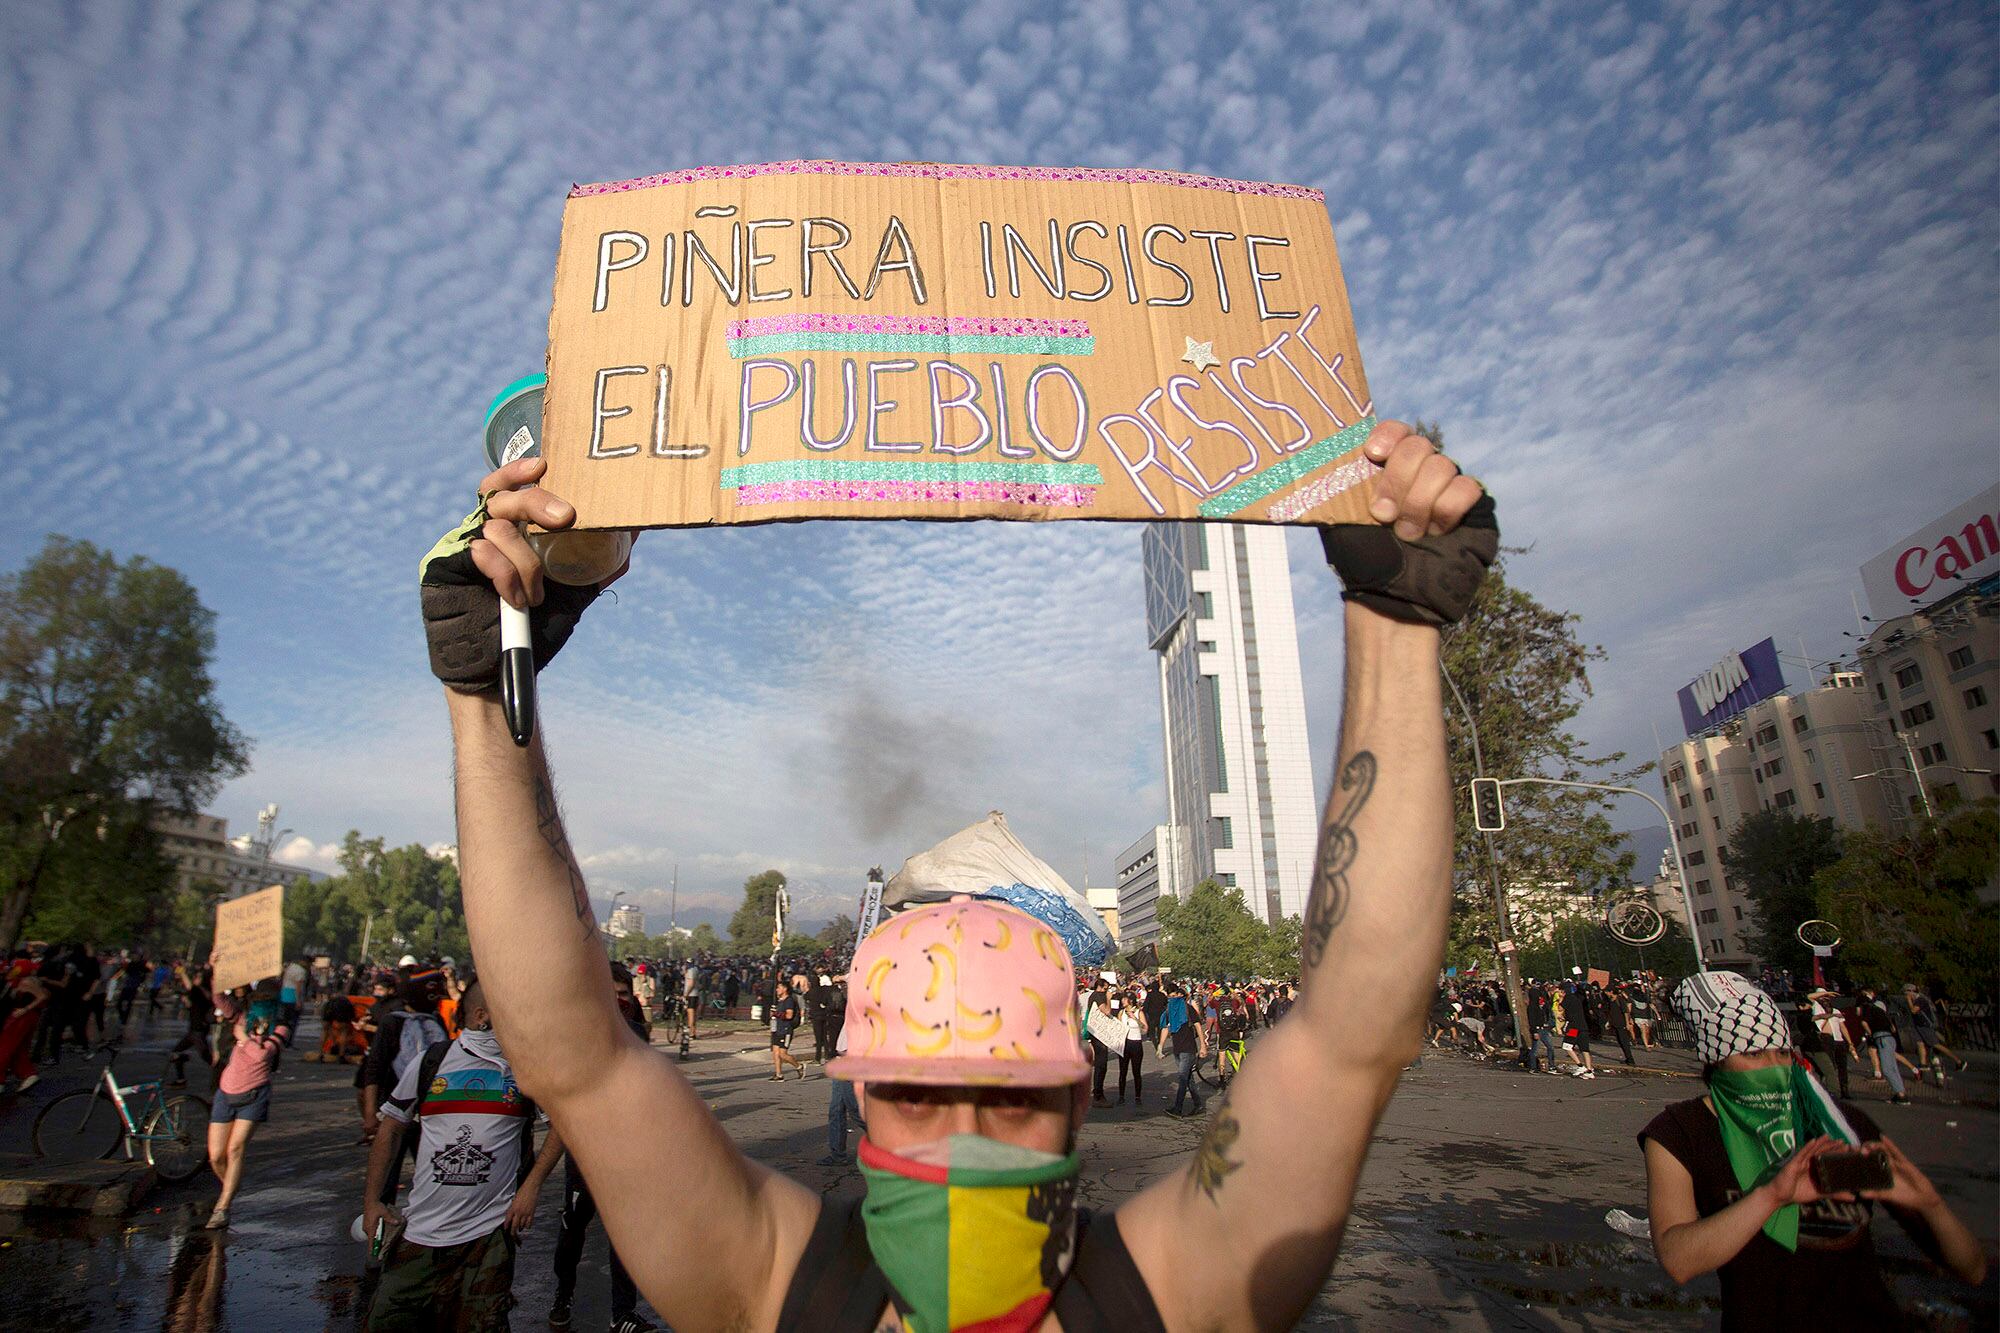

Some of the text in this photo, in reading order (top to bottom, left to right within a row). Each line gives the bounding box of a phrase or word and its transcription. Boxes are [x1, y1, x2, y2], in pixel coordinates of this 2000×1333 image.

[591, 204, 1300, 322] PIÑERA INSISTE
[588, 304, 1374, 517] EL PUEBLO RESISTE
[1895, 513, 2000, 597] Can
[1690, 648, 1750, 717] WOM
